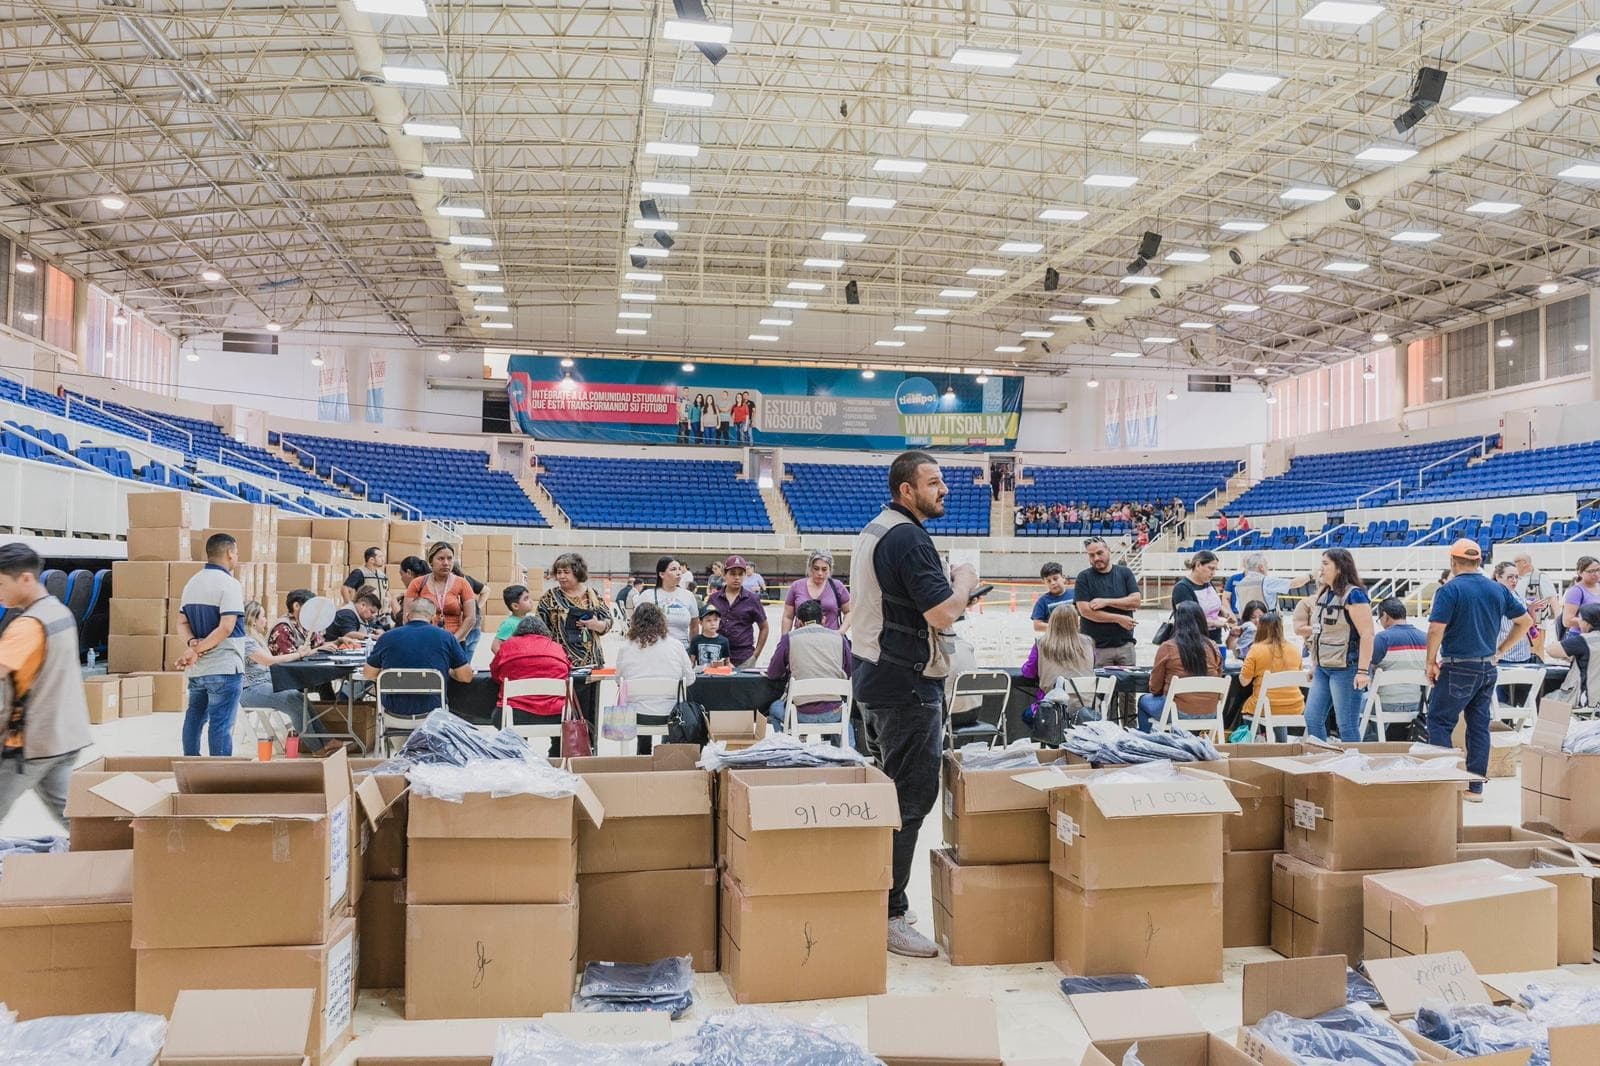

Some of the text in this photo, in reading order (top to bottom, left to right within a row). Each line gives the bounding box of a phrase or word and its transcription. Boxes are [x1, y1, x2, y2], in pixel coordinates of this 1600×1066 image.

[578, 391, 587, 401] LA
[588, 391, 631, 403] COMUNIDAD
[632, 393, 676, 404] ESTUDIANTIL
[532, 400, 546, 410] QUE
[566, 401, 628, 412] TRANSFORMANDO
[629, 402, 640, 412] SU
[641, 402, 668, 413] FUTURO
[765, 399, 812, 416] ESTUDIA
[814, 401, 837, 416] CON
[765, 414, 823, 430] NOSOTROS
[904, 415, 1007, 435] WWW.ITSON.MX
[794, 805, 818, 825] 16
